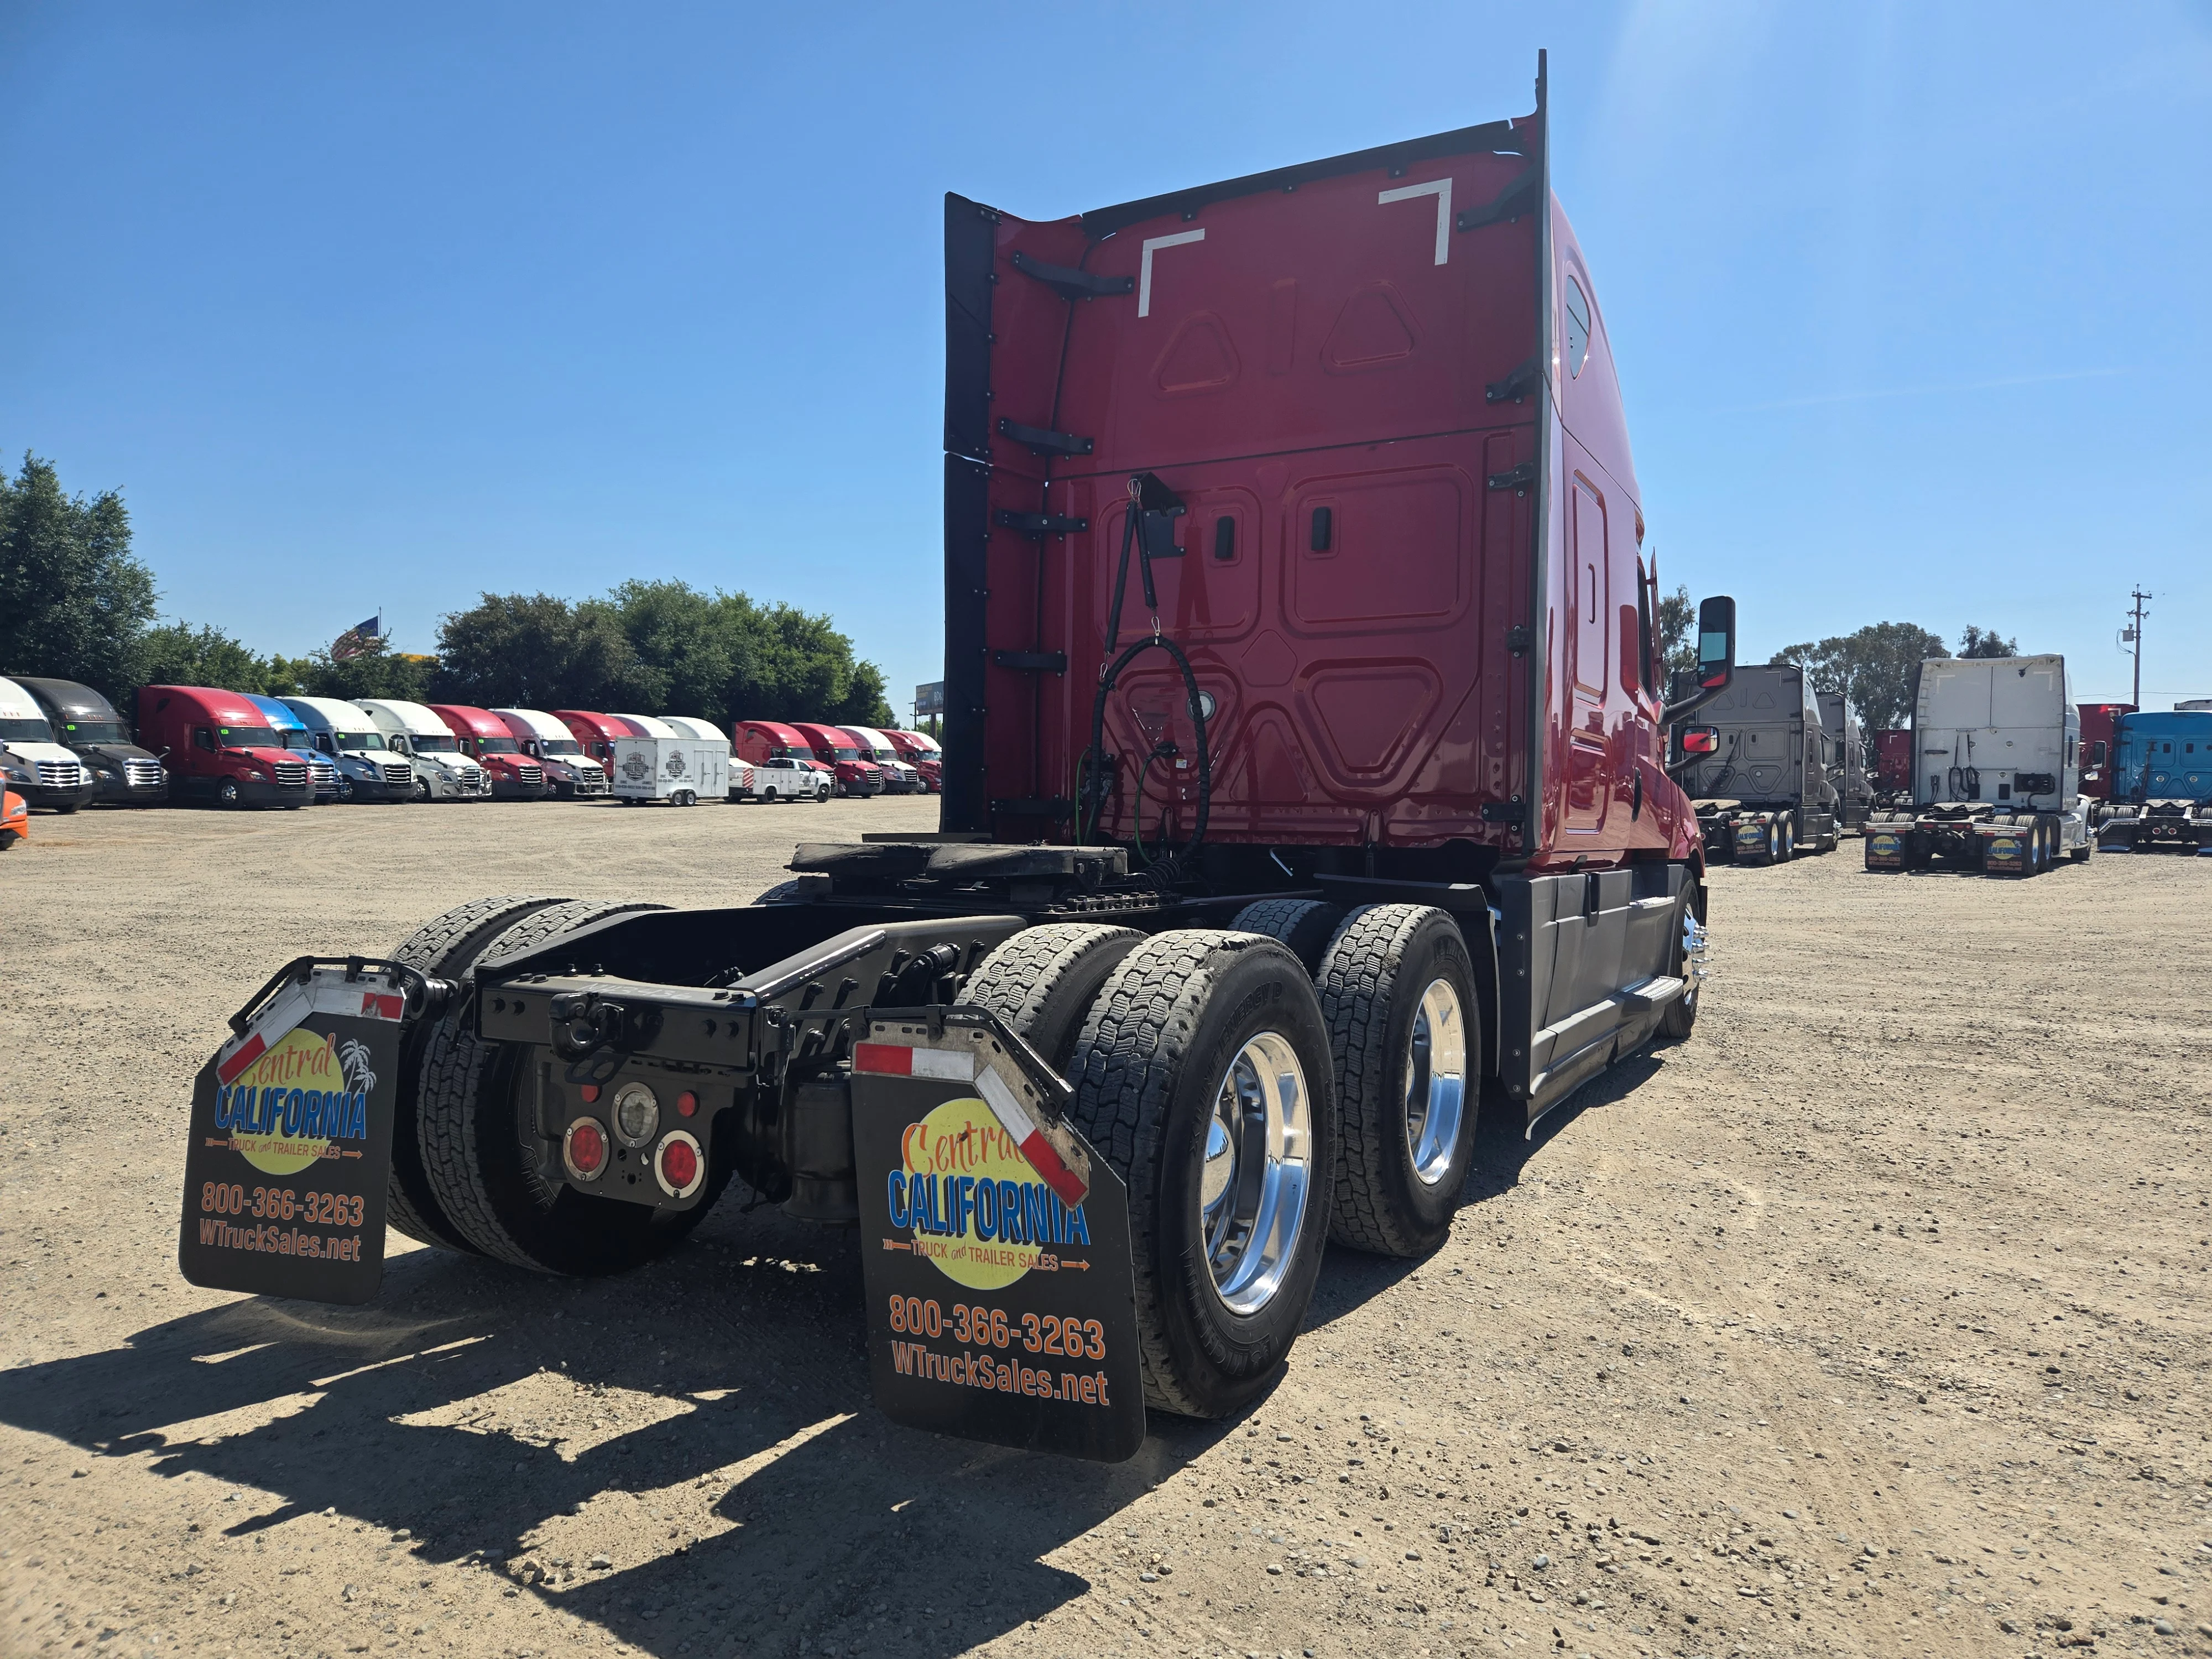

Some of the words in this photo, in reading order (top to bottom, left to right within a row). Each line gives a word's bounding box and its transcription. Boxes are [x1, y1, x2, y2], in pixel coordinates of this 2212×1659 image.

[1218, 980, 1271, 1057] ENERGY
[215, 1085, 366, 1139] CALIFORNIA
[228, 1138, 257, 1152] TRUCK
[258, 1139, 272, 1152] and
[273, 1142, 309, 1156] TRAILER
[311, 1143, 341, 1159] SALES
[201, 1182, 364, 1227] 800-366-3263
[888, 1170, 1091, 1245] CALIFORNIA
[200, 1218, 361, 1262] WTruckSales.net
[911, 1240, 947, 1259] TRUCK
[951, 1244, 966, 1260] and
[968, 1246, 1015, 1267] TRAILER
[1019, 1253, 1058, 1271] SALES
[889, 1294, 1105, 1360] 800-366-3263
[891, 1339, 1109, 1406] WTruckSales.net
